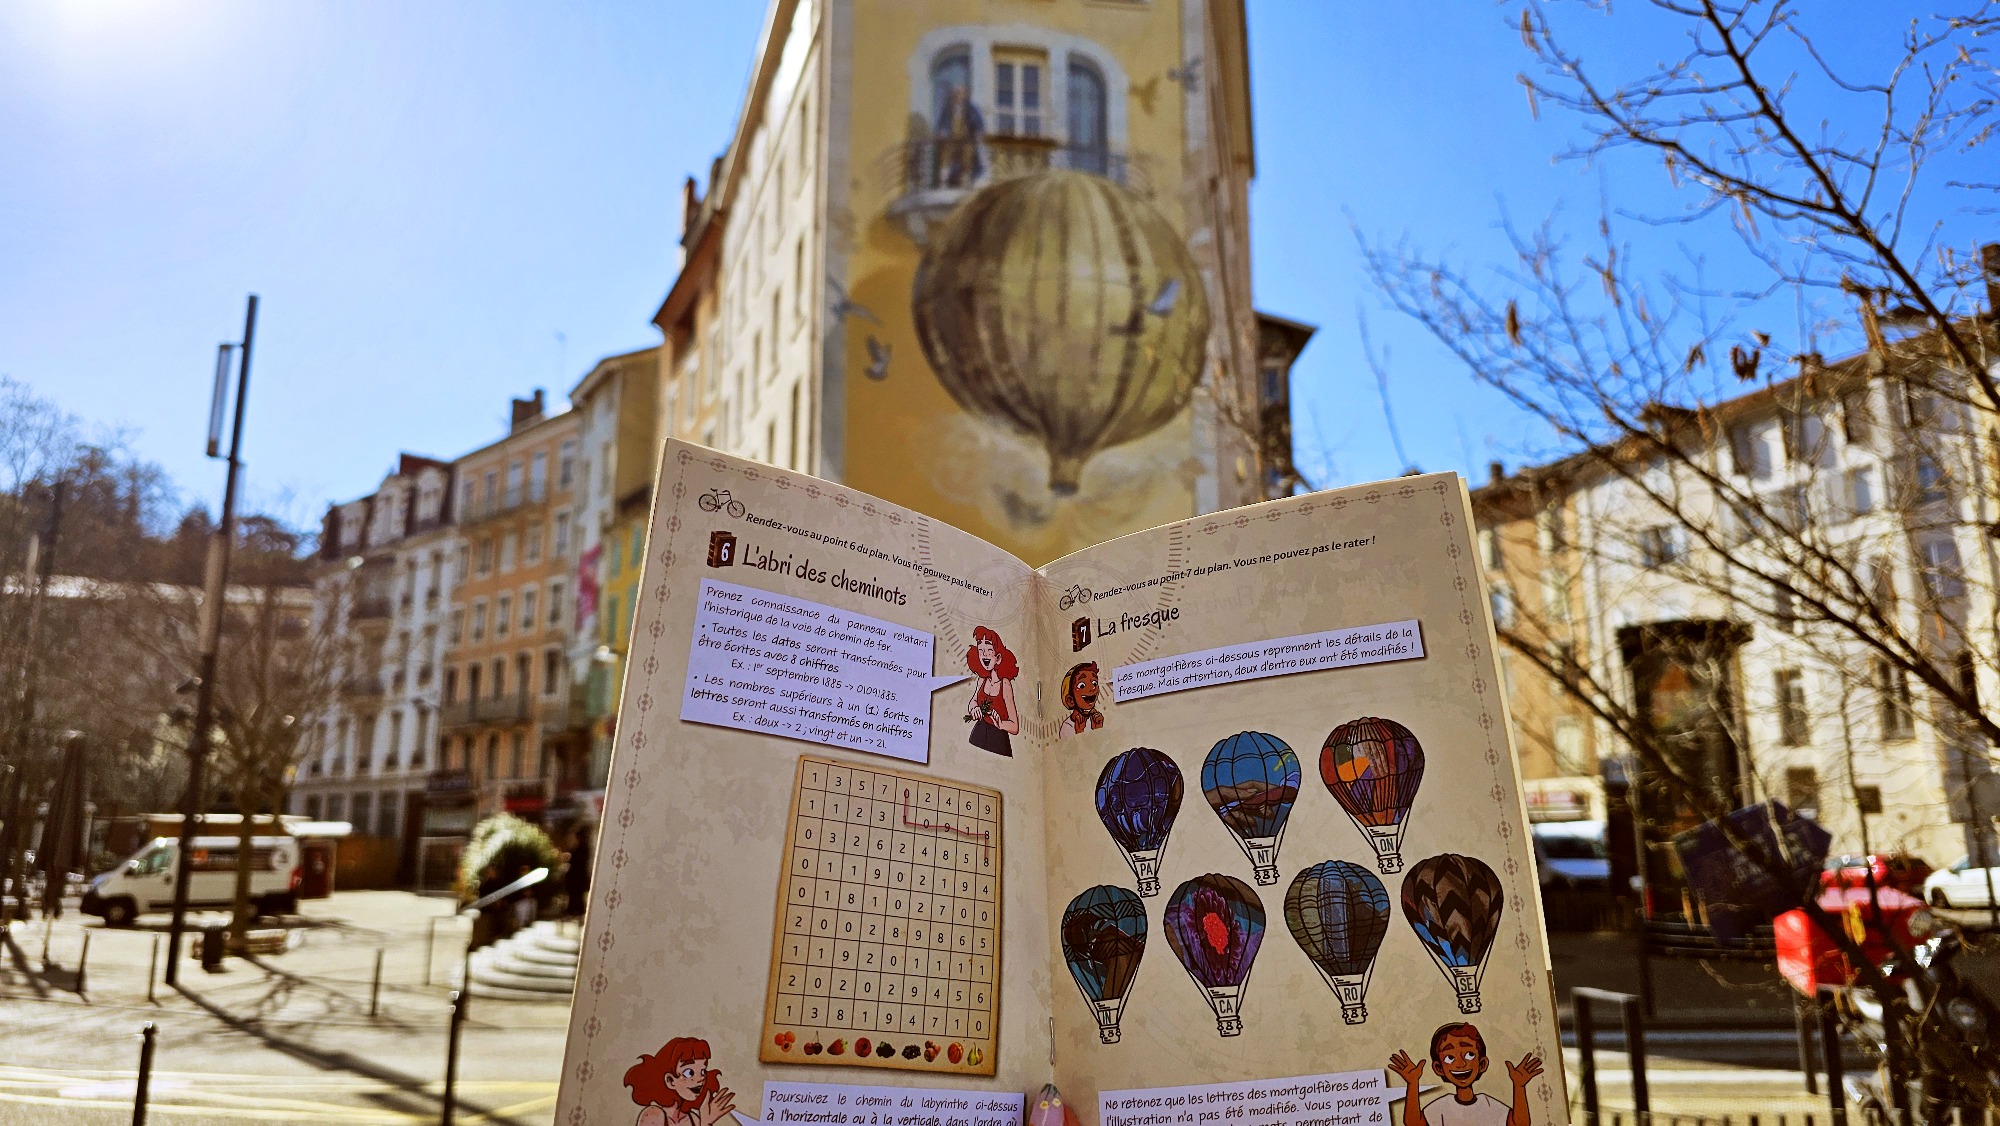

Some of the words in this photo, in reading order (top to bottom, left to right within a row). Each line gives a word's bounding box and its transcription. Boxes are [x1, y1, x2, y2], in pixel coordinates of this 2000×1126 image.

[721, 541, 731, 562] 6
[745, 513, 809, 537] Rendez-vous
[810, 531, 822, 541] au
[822, 535, 848, 549] point
[849, 542, 856, 551] 6
[857, 544, 868, 555] du
[869, 548, 890, 561] plan.
[892, 554, 911, 568] Vous
[912, 563, 923, 572] ne
[923, 567, 951, 582] pouvez
[951, 577, 964, 587] pas
[964, 580, 972, 590] le
[972, 585, 990, 597] rater
[742, 543, 793, 575] L'abri
[795, 558, 827, 584] des
[831, 568, 907, 606] cheminots
[1093, 582, 1146, 601] Rendez-vous
[1147, 577, 1159, 587] au
[1159, 571, 1185, 586] point
[1186, 568, 1192, 578] 7
[1193, 566, 1206, 576] du
[1207, 562, 1232, 576] plan.
[1232, 557, 1257, 568] Vous
[1259, 554, 1272, 564] ne
[1273, 547, 1310, 563] pouvez
[1311, 543, 1330, 557] pas
[1331, 541, 1342, 551] le
[1343, 537, 1370, 549] rater
[703, 600, 763, 623] l'historique
[765, 614, 778, 625] de
[780, 617, 790, 628] la
[792, 623, 812, 633] voie
[814, 625, 827, 636] de
[828, 629, 862, 645] chemin
[863, 637, 875, 648] de
[876, 639, 893, 653] fer.
[706, 586, 743, 602] Prenez
[751, 597, 820, 619] connaissance
[827, 614, 840, 624] du
[846, 620, 887, 636] panneau
[893, 632, 929, 648] relatant
[1097, 618, 1117, 638] La
[1120, 607, 1180, 633] fresque
[1080, 625, 1087, 643] 7
[698, 633, 722, 649] être
[723, 639, 762, 657] écrites
[763, 651, 789, 662] avec
[790, 654, 798, 665] 8
[799, 656, 840, 673] chiffres
[712, 622, 748, 638] Toutes
[752, 631, 767, 642] les
[771, 634, 801, 650] dates
[805, 643, 838, 657] seront
[840, 649, 903, 673] transformées
[906, 668, 927, 679] pour
[1117, 672, 1133, 682] Les
[1136, 658, 1203, 678] montgolfières
[1205, 650, 1260, 666] ci-dessous
[1263, 639, 1322, 659] reprennent
[1325, 638, 1341, 648] les
[1344, 632, 1382, 646] détails
[1385, 629, 1399, 641] de
[1402, 628, 1413, 638] la
[731, 658, 745, 670] Ex.
[765, 666, 819, 685] septembre
[822, 677, 842, 689] 1885
[1118, 681, 1156, 697] fresque.
[1158, 676, 1180, 688] Mais
[1182, 669, 1233, 684] attention,
[1234, 663, 1258, 676] deux
[1260, 658, 1297, 672] d'entre
[1299, 656, 1317, 667] eux
[1319, 652, 1339, 663] ont
[1340, 648, 1358, 661] été
[1361, 640, 1408, 659] modifiés
[690, 687, 729, 703] lettres
[731, 696, 768, 709] seront
[769, 703, 797, 715] aussi
[798, 706, 861, 728] transformés
[862, 721, 874, 730] en
[875, 722, 913, 739] chiffres
[704, 673, 724, 686] Les
[729, 679, 776, 695] nombres
[779, 689, 833, 706] supérieurs
[836, 696, 844, 709] à
[847, 703, 860, 712] un
[865, 703, 880, 716] (1)
[883, 707, 910, 723] écrits
[912, 716, 924, 726] en
[732, 711, 746, 723] Ex.
[754, 715, 780, 728] deux
[795, 723, 802, 732] 2
[809, 725, 836, 742] vingt
[836, 730, 849, 741] et
[849, 734, 862, 744] un
[876, 738, 887, 749] 21.
[812, 772, 817, 783] 1
[835, 776, 842, 787] 3
[859, 780, 866, 791] 5
[882, 784, 888, 795] 7
[925, 792, 931, 803] 2
[945, 797, 952, 807] 4
[965, 800, 972, 811] 6
[985, 804, 991, 815] 9
[1257, 850, 1270, 865] NT
[1379, 837, 1394, 853] ON
[1140, 861, 1154, 878] PA
[1343, 985, 1359, 1002] RO
[1460, 976, 1474, 992] SE
[1102, 1010, 1112, 1026] IN
[1219, 999, 1234, 1015] CA
[769, 1090, 829, 1104] Poursuivez
[837, 1093, 847, 1105] le
[855, 1094, 892, 1107] chemin
[900, 1096, 913, 1108] du
[921, 1096, 969, 1112] labyrinthe
[975, 1099, 1018, 1112] ci-dessus
[1105, 1099, 1119, 1110] Ne
[1121, 1096, 1162, 1109] retenez
[1164, 1096, 1186, 1109] que
[1188, 1093, 1204, 1105] les
[1206, 1090, 1244, 1103] lettres
[1247, 1087, 1267, 1100] des
[1269, 1079, 1349, 1101] montgolfières
[1351, 1077, 1379, 1091] dont
[766, 1107, 775, 1121] à
[780, 1107, 848, 1124] l'horizontale
[852, 1115, 866, 1125] ou
[870, 1112, 878, 1125] à
[883, 1113, 893, 1126] la
[945, 1115, 969, 1126] dans
[1106, 1113, 1172, 1126] l'illustration
[1177, 1109, 1193, 1122] n'a
[1199, 1110, 1220, 1125] pas
[1225, 1104, 1244, 1119] été
[1248, 1100, 1300, 1117] modifiée.
[1304, 1100, 1332, 1111] Vous
[1336, 1096, 1381, 1112] pourrez
[1368, 1111, 1383, 1123] de
